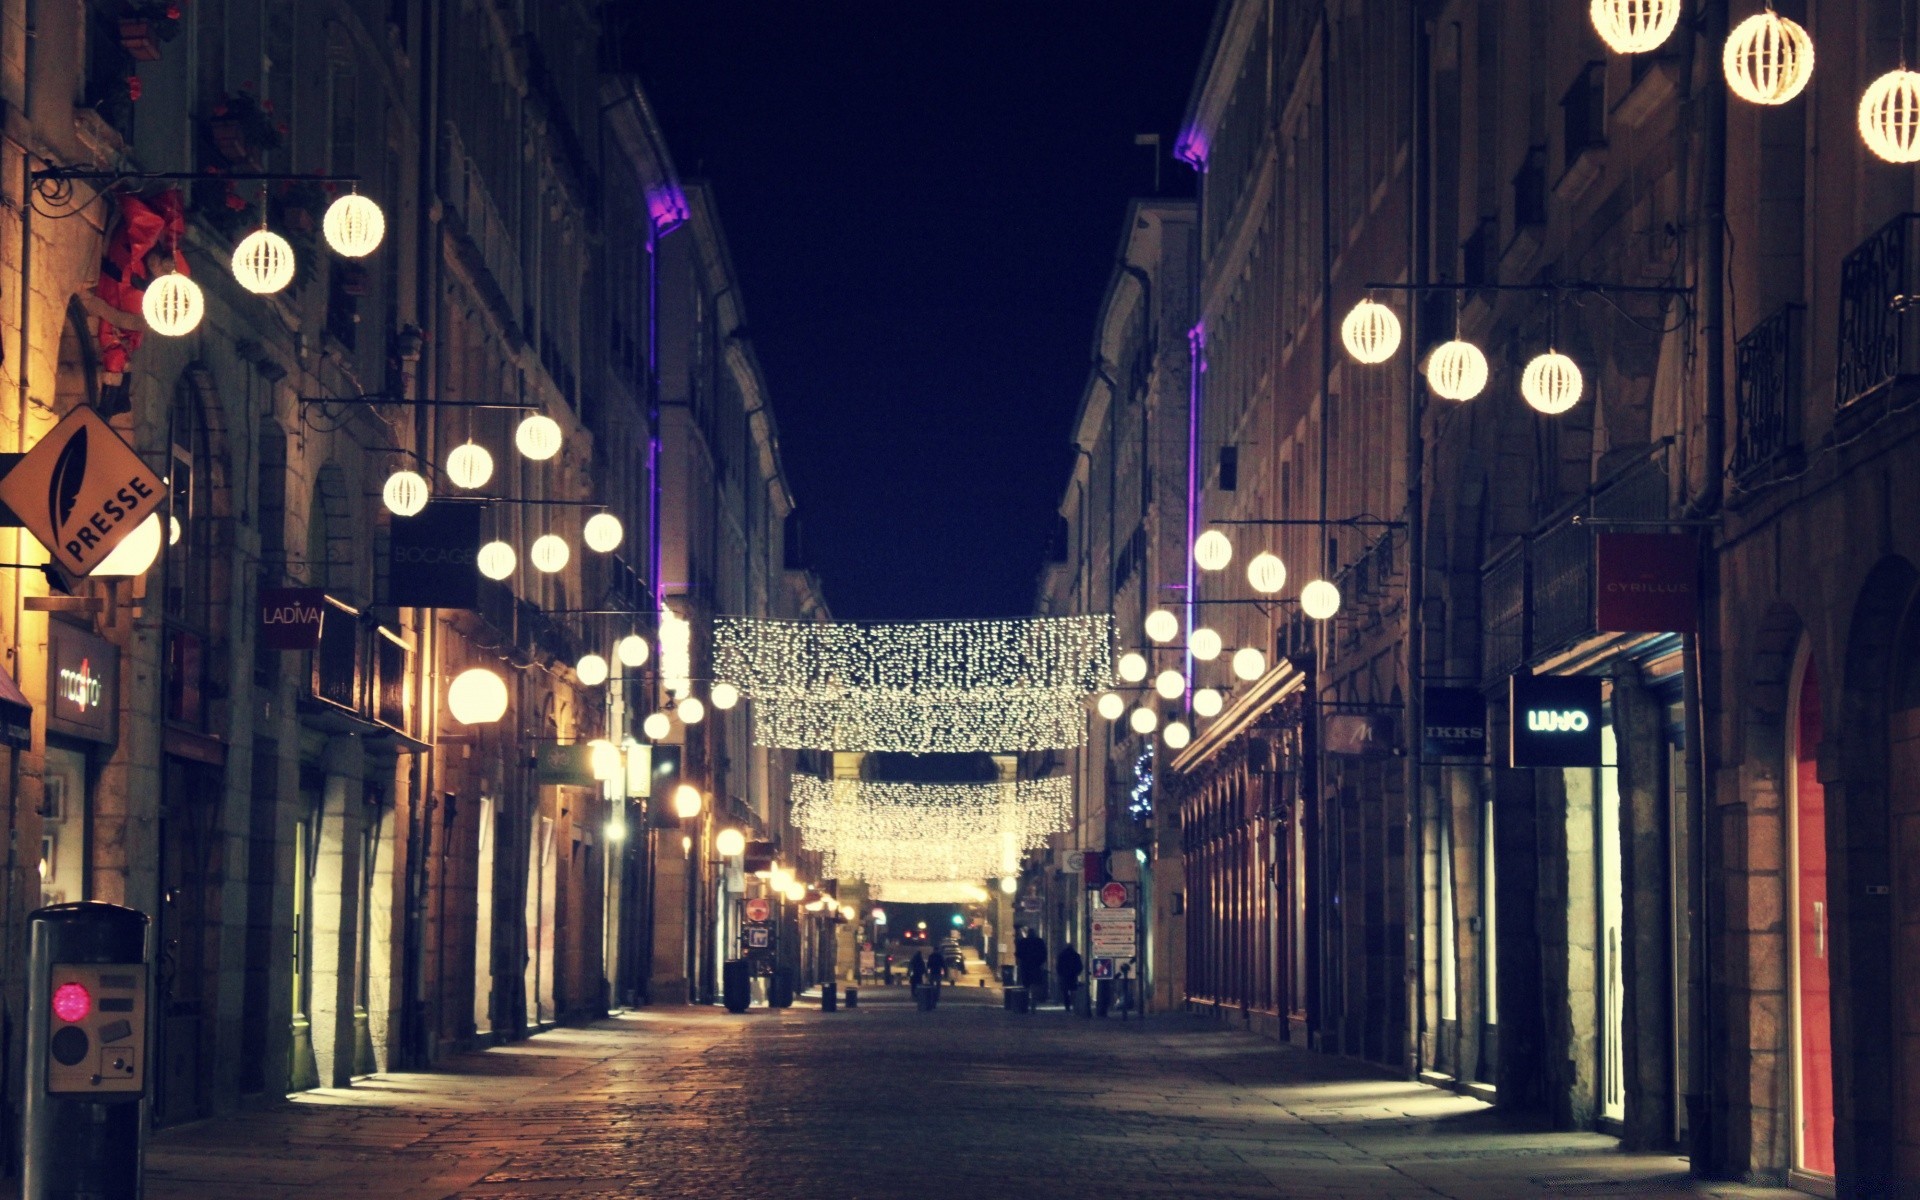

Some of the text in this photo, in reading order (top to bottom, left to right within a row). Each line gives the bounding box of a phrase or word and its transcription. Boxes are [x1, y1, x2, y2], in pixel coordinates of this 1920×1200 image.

[66, 477, 153, 563] PRESSE
[396, 545, 473, 564] BOCAGE
[1607, 583, 1689, 592] CYRILLUS
[1425, 727, 1483, 738] IKKS
